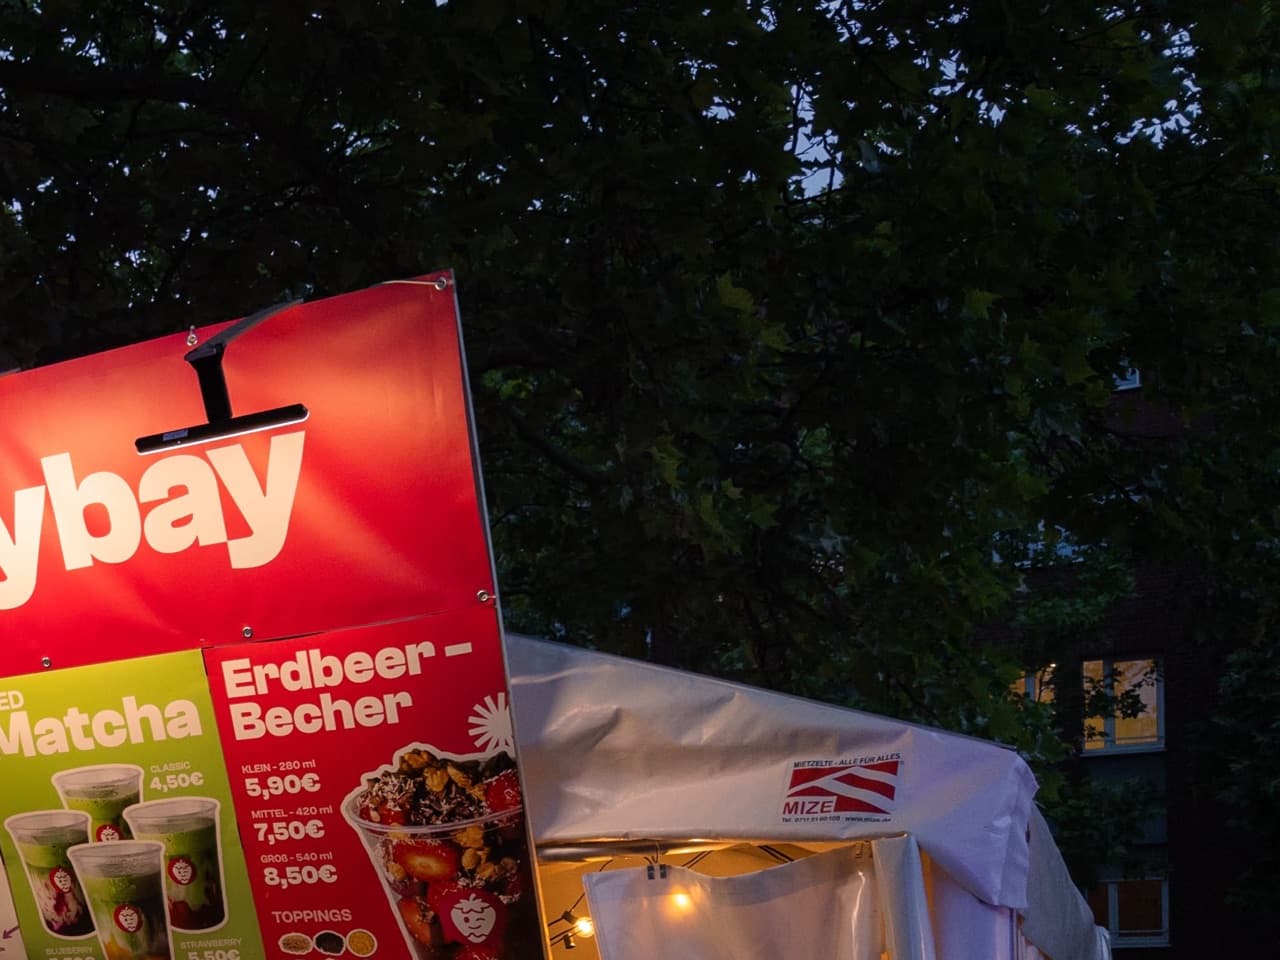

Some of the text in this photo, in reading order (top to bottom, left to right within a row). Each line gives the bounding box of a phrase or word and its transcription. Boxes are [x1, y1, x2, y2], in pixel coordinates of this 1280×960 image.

[229, 691, 413, 741] Becher
[877, 753, 901, 761] ALLES
[150, 761, 191, 772] CLASSIC
[241, 763, 271, 774] KLEIN
[279, 760, 300, 771] 280
[302, 759, 316, 768] ml
[150, 772, 205, 792] 4,50€
[245, 773, 321, 800] 5,90€
[251, 809, 288, 819] MITTEL
[296, 806, 318, 816] 420
[320, 804, 333, 814] ml
[782, 800, 834, 815] MIZE
[253, 820, 325, 845] 7,50€
[296, 852, 318, 862] 540
[320, 852, 333, 860] ml
[264, 864, 338, 889] 8,50€
[272, 909, 352, 924] TOPPINGS
[46, 945, 93, 956] BLUEBERRY
[180, 937, 242, 950] STRAWBERRY
